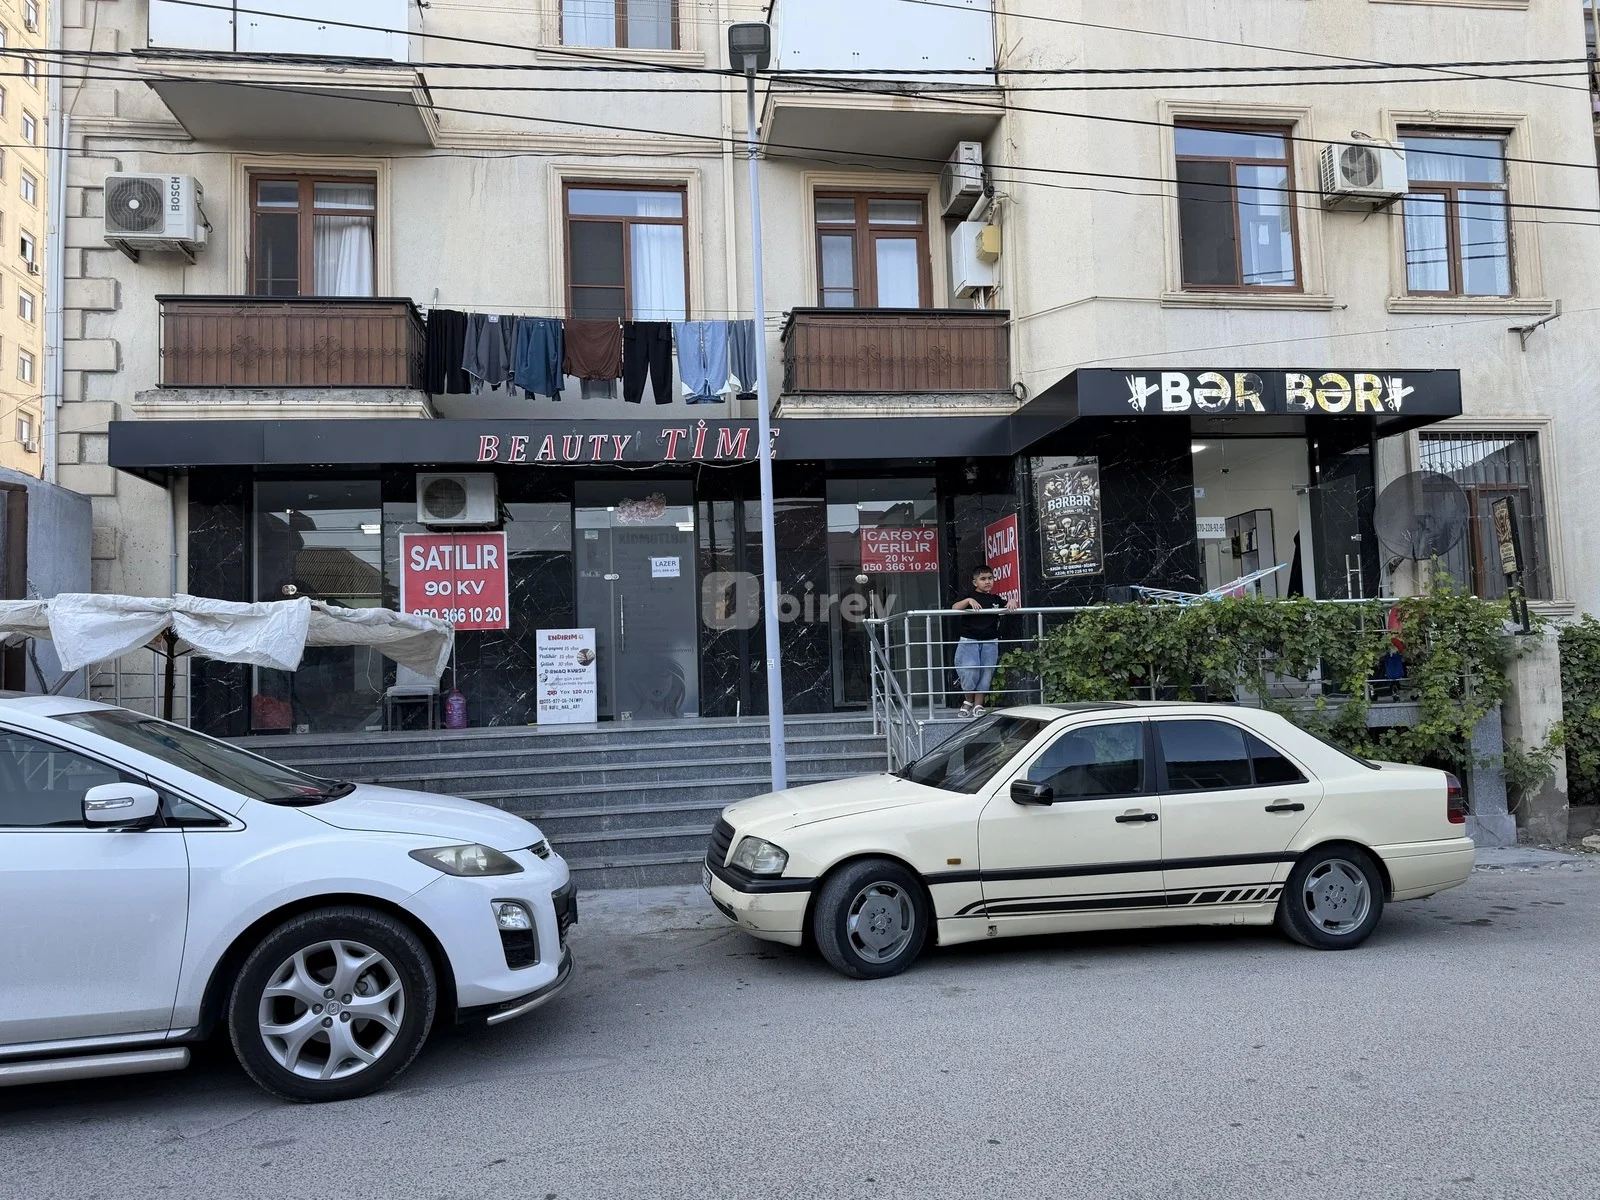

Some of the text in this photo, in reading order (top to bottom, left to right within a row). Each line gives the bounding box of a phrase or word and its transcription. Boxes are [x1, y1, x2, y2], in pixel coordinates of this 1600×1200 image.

[171, 177, 180, 211] BOSCH
[1286, 373, 1384, 412] BƏR
[477, 435, 632, 462] BEAUTY
[862, 529, 935, 541] İCARƏYƏ
[987, 526, 1015, 559] SATILIR
[867, 540, 931, 553] VERİLİR
[410, 544, 499, 571] SATILIR
[885, 554, 914, 562] 20 kv
[863, 562, 937, 571] 050 366 10 20
[992, 563, 1011, 581] 90 KV
[424, 580, 485, 596] 90 KV
[441, 607, 466, 622] 366
[469, 607, 482, 622] 10
[485, 606, 501, 622] 20
